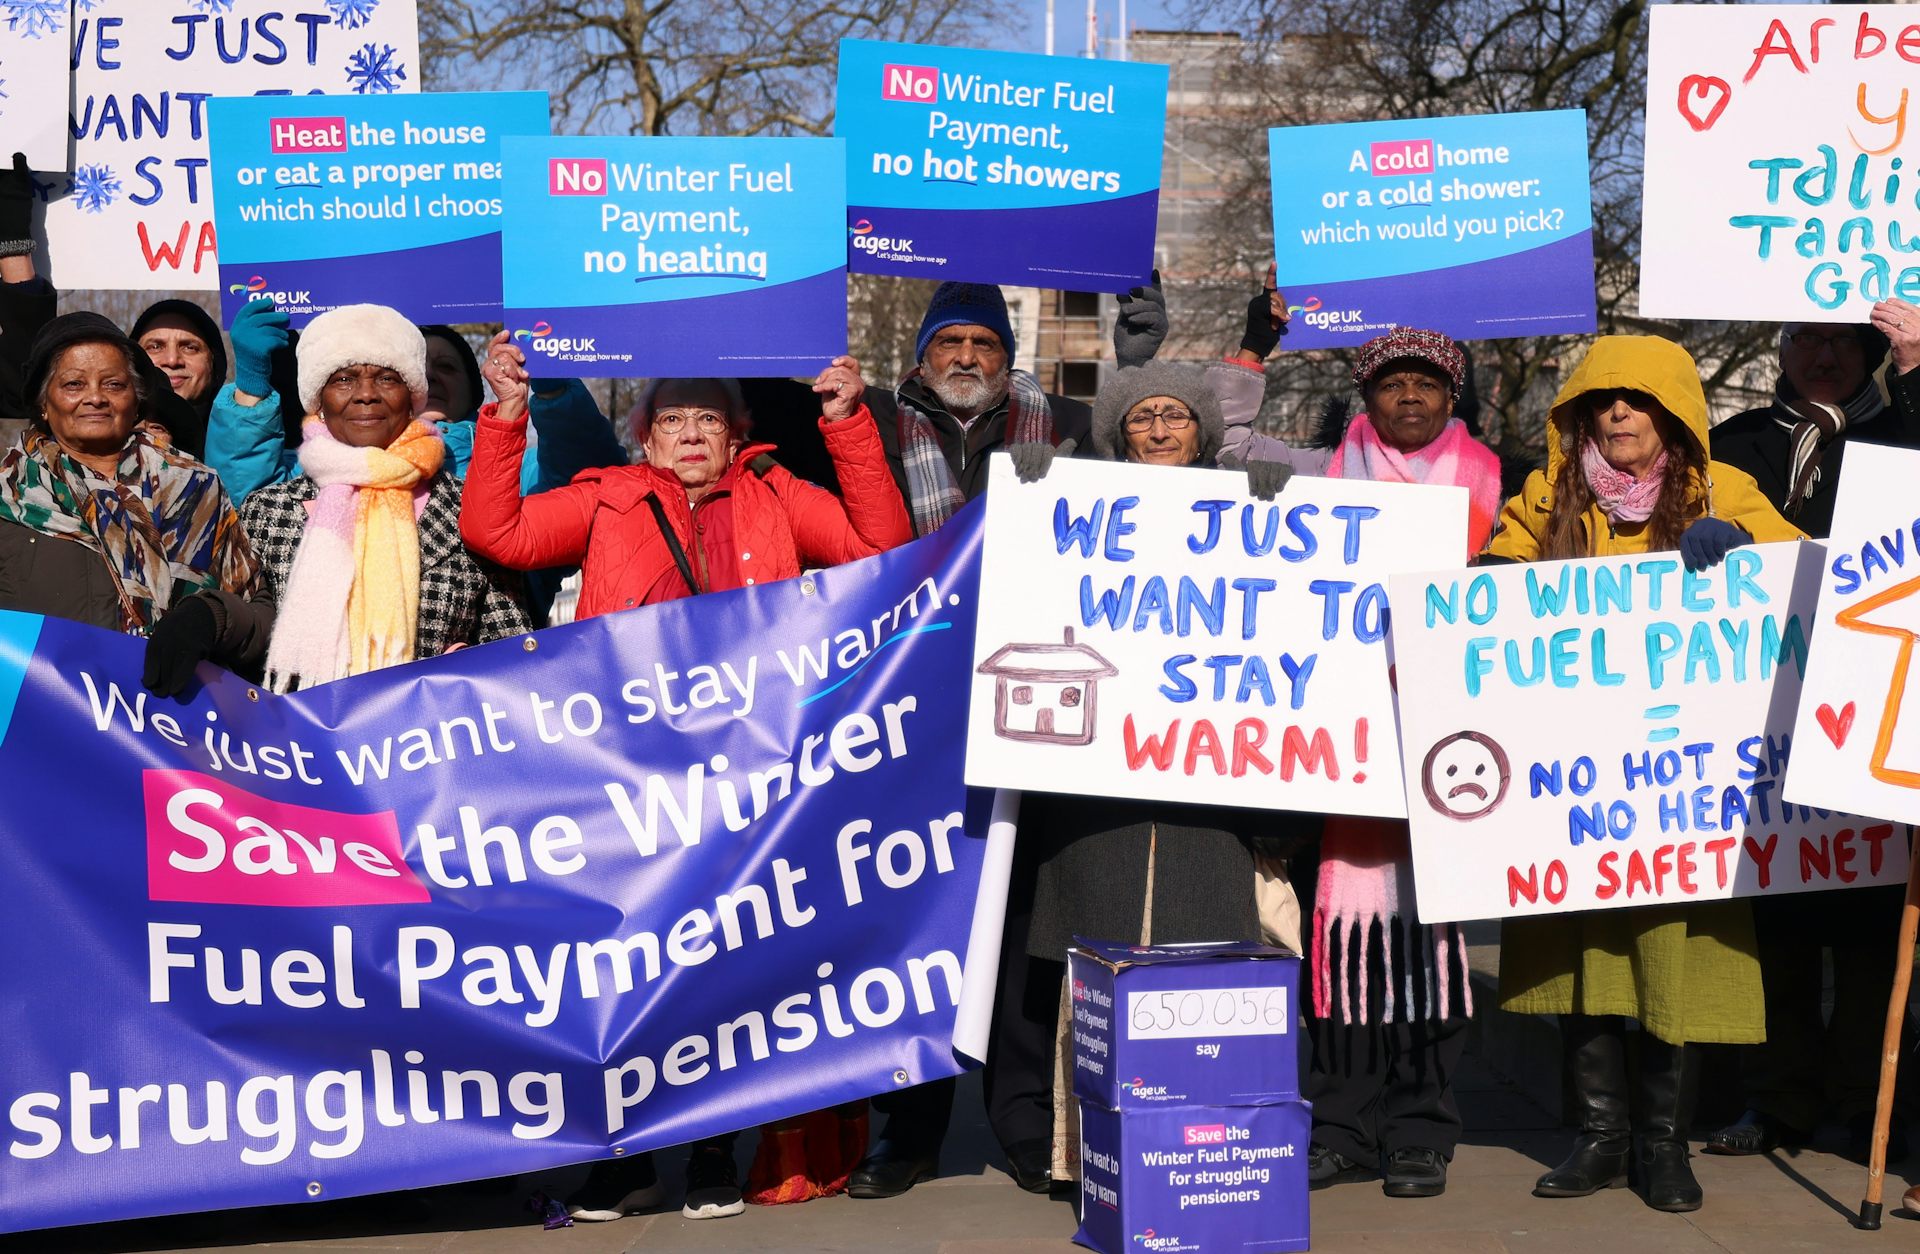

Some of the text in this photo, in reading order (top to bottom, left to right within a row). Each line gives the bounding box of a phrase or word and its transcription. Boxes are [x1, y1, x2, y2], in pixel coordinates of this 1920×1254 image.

[166, 13, 331, 65] JUST
[891, 69, 1113, 113] No Winter Fuel
[928, 112, 1069, 153] Payment,
[1847, 82, 1908, 156] y
[277, 122, 485, 146] Heat the house
[874, 149, 1119, 192] no hot showers
[1350, 144, 1508, 171] A cold home
[238, 168, 266, 184] or
[276, 163, 320, 184] eat
[329, 167, 345, 182] a
[354, 164, 444, 188] proper
[558, 163, 792, 192] No Winter Fuel
[240, 198, 313, 220] which
[323, 195, 405, 219] should
[415, 196, 419, 216] I
[1323, 179, 1539, 208] or a cold shower:
[603, 204, 748, 240] Payment,
[1302, 209, 1564, 244] which would you pick?
[853, 235, 913, 255] ageUK
[877, 251, 891, 260] Let's
[890, 252, 913, 262] change
[913, 254, 927, 262] how
[936, 257, 947, 265] age
[585, 243, 766, 277] no heating
[290, 306, 313, 314] change
[1304, 310, 1362, 329] ageUK
[1328, 324, 1342, 332] Let's
[1342, 324, 1365, 333] change
[1385, 322, 1397, 330] age
[532, 338, 596, 357] ageUK
[559, 353, 574, 361] Let's
[573, 353, 597, 362] change
[597, 353, 611, 361] how
[621, 354, 633, 362] age
[1054, 496, 1380, 564] WE JUST
[1831, 518, 1920, 595] SAV
[1425, 549, 1770, 628] NO WINTER
[1080, 575, 1391, 644] WANT TO
[1464, 613, 1817, 698] FUEL PAYM
[79, 577, 960, 786] We just want to stay warm.
[1158, 652, 1318, 710] STAY
[1123, 713, 1368, 784] WARM!
[1529, 754, 1597, 800] NO
[1623, 742, 1714, 792] HOT
[167, 695, 917, 889] Save the Winter
[1568, 801, 1637, 846] NO
[1507, 824, 1894, 908] NO SAFETY NET
[147, 811, 964, 1027] Fuel Payment for
[1092, 989, 1112, 1008] Winter
[1084, 1010, 1108, 1030] Payment
[1081, 1032, 1108, 1057] struggling
[1197, 1045, 1220, 1058] say
[1132, 1086, 1167, 1099] ageUK
[8, 1049, 566, 1166] struggling
[1188, 1126, 1249, 1142] Save the
[1092, 1151, 1110, 1172] want
[1111, 1155, 1119, 1175] to
[1142, 1144, 1294, 1166] Winter Fuel Payment
[1170, 1167, 1269, 1185] for struggling
[1084, 1176, 1118, 1206] stay warm
[1181, 1191, 1259, 1209] pensioners
[1144, 1237, 1179, 1251] ageUK
